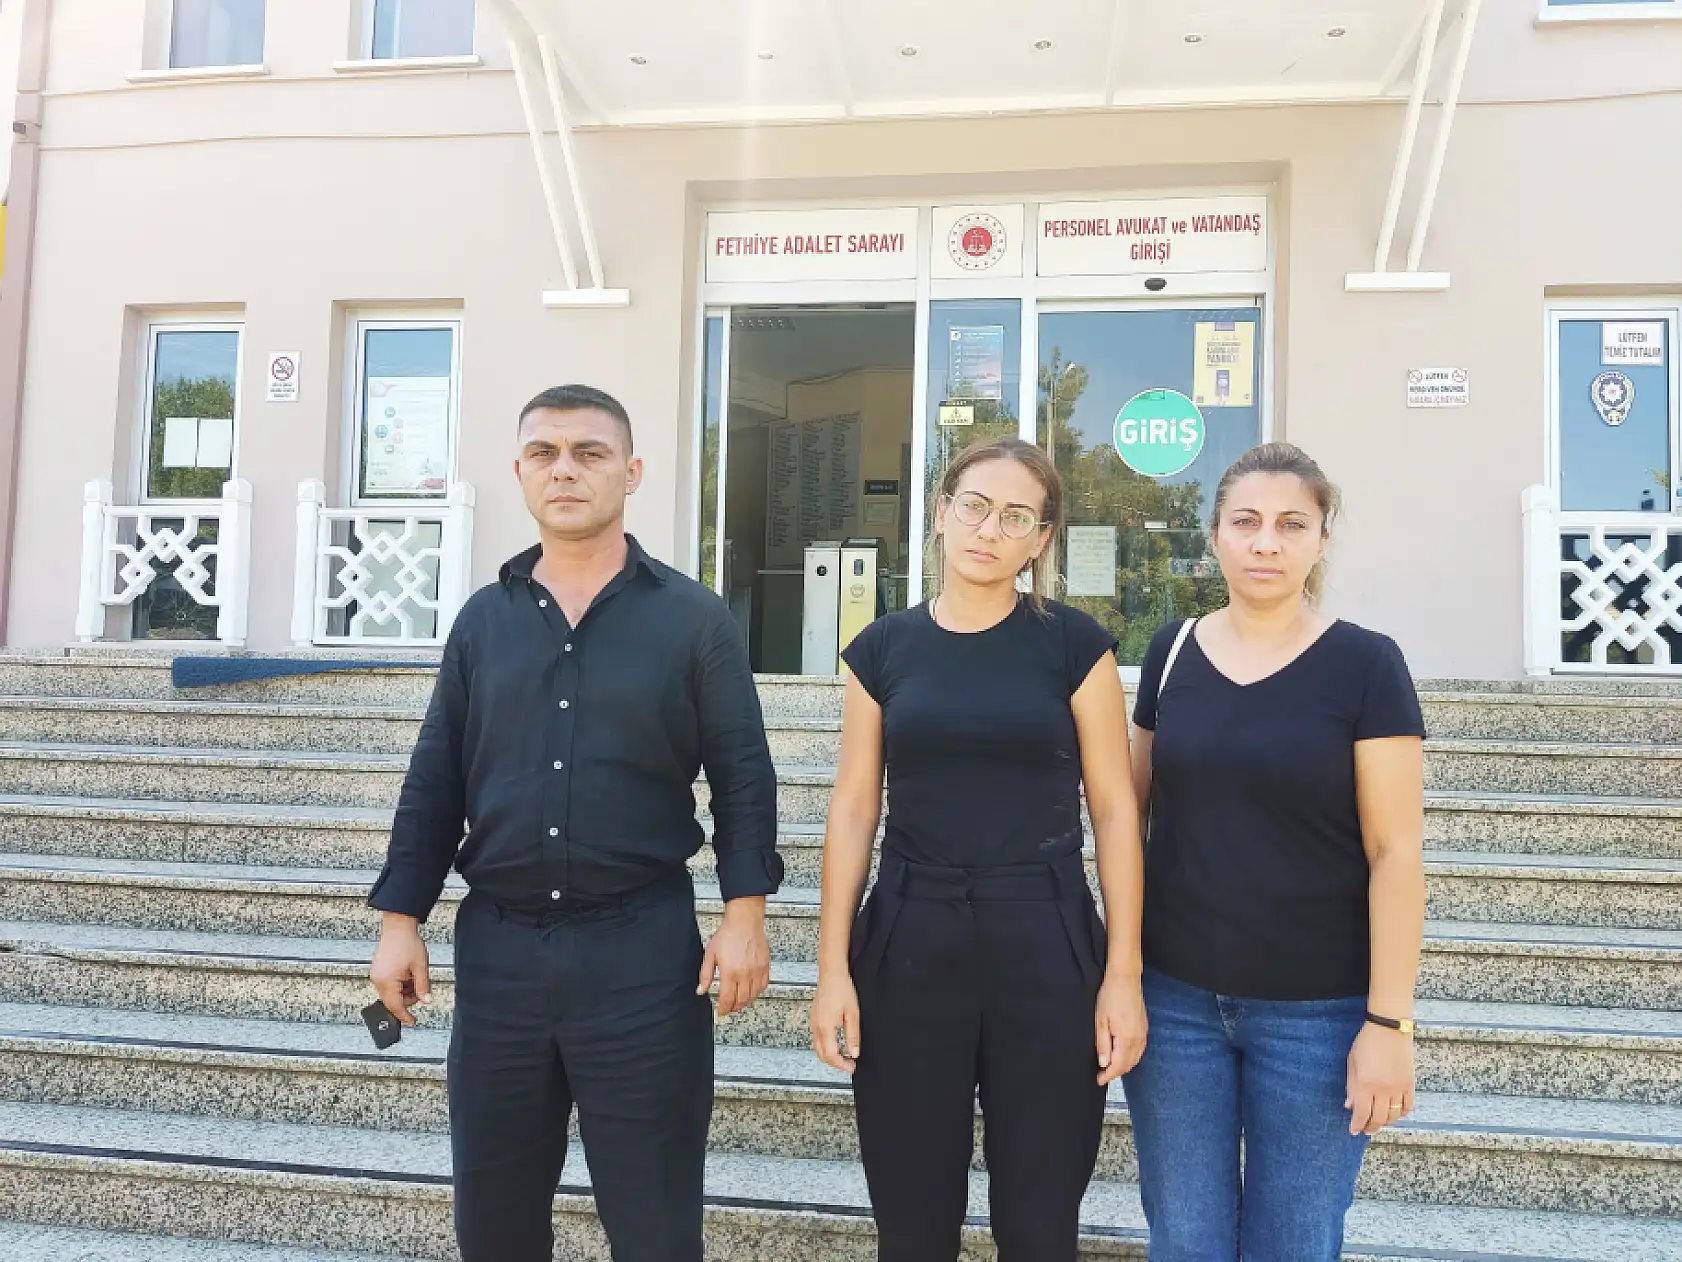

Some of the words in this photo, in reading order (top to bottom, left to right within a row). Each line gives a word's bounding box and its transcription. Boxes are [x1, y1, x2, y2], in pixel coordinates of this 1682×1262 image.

[1044, 218, 1112, 237] PERSONEL
[1116, 216, 1168, 236] AVUKAT
[1171, 219, 1188, 234] ve
[1192, 213, 1261, 236] VATANDAŞ
[715, 233, 779, 257] FETHİYE
[783, 234, 842, 255] ADALET
[847, 232, 905, 254] SARAYI
[1130, 239, 1171, 264] GİRİŞİ
